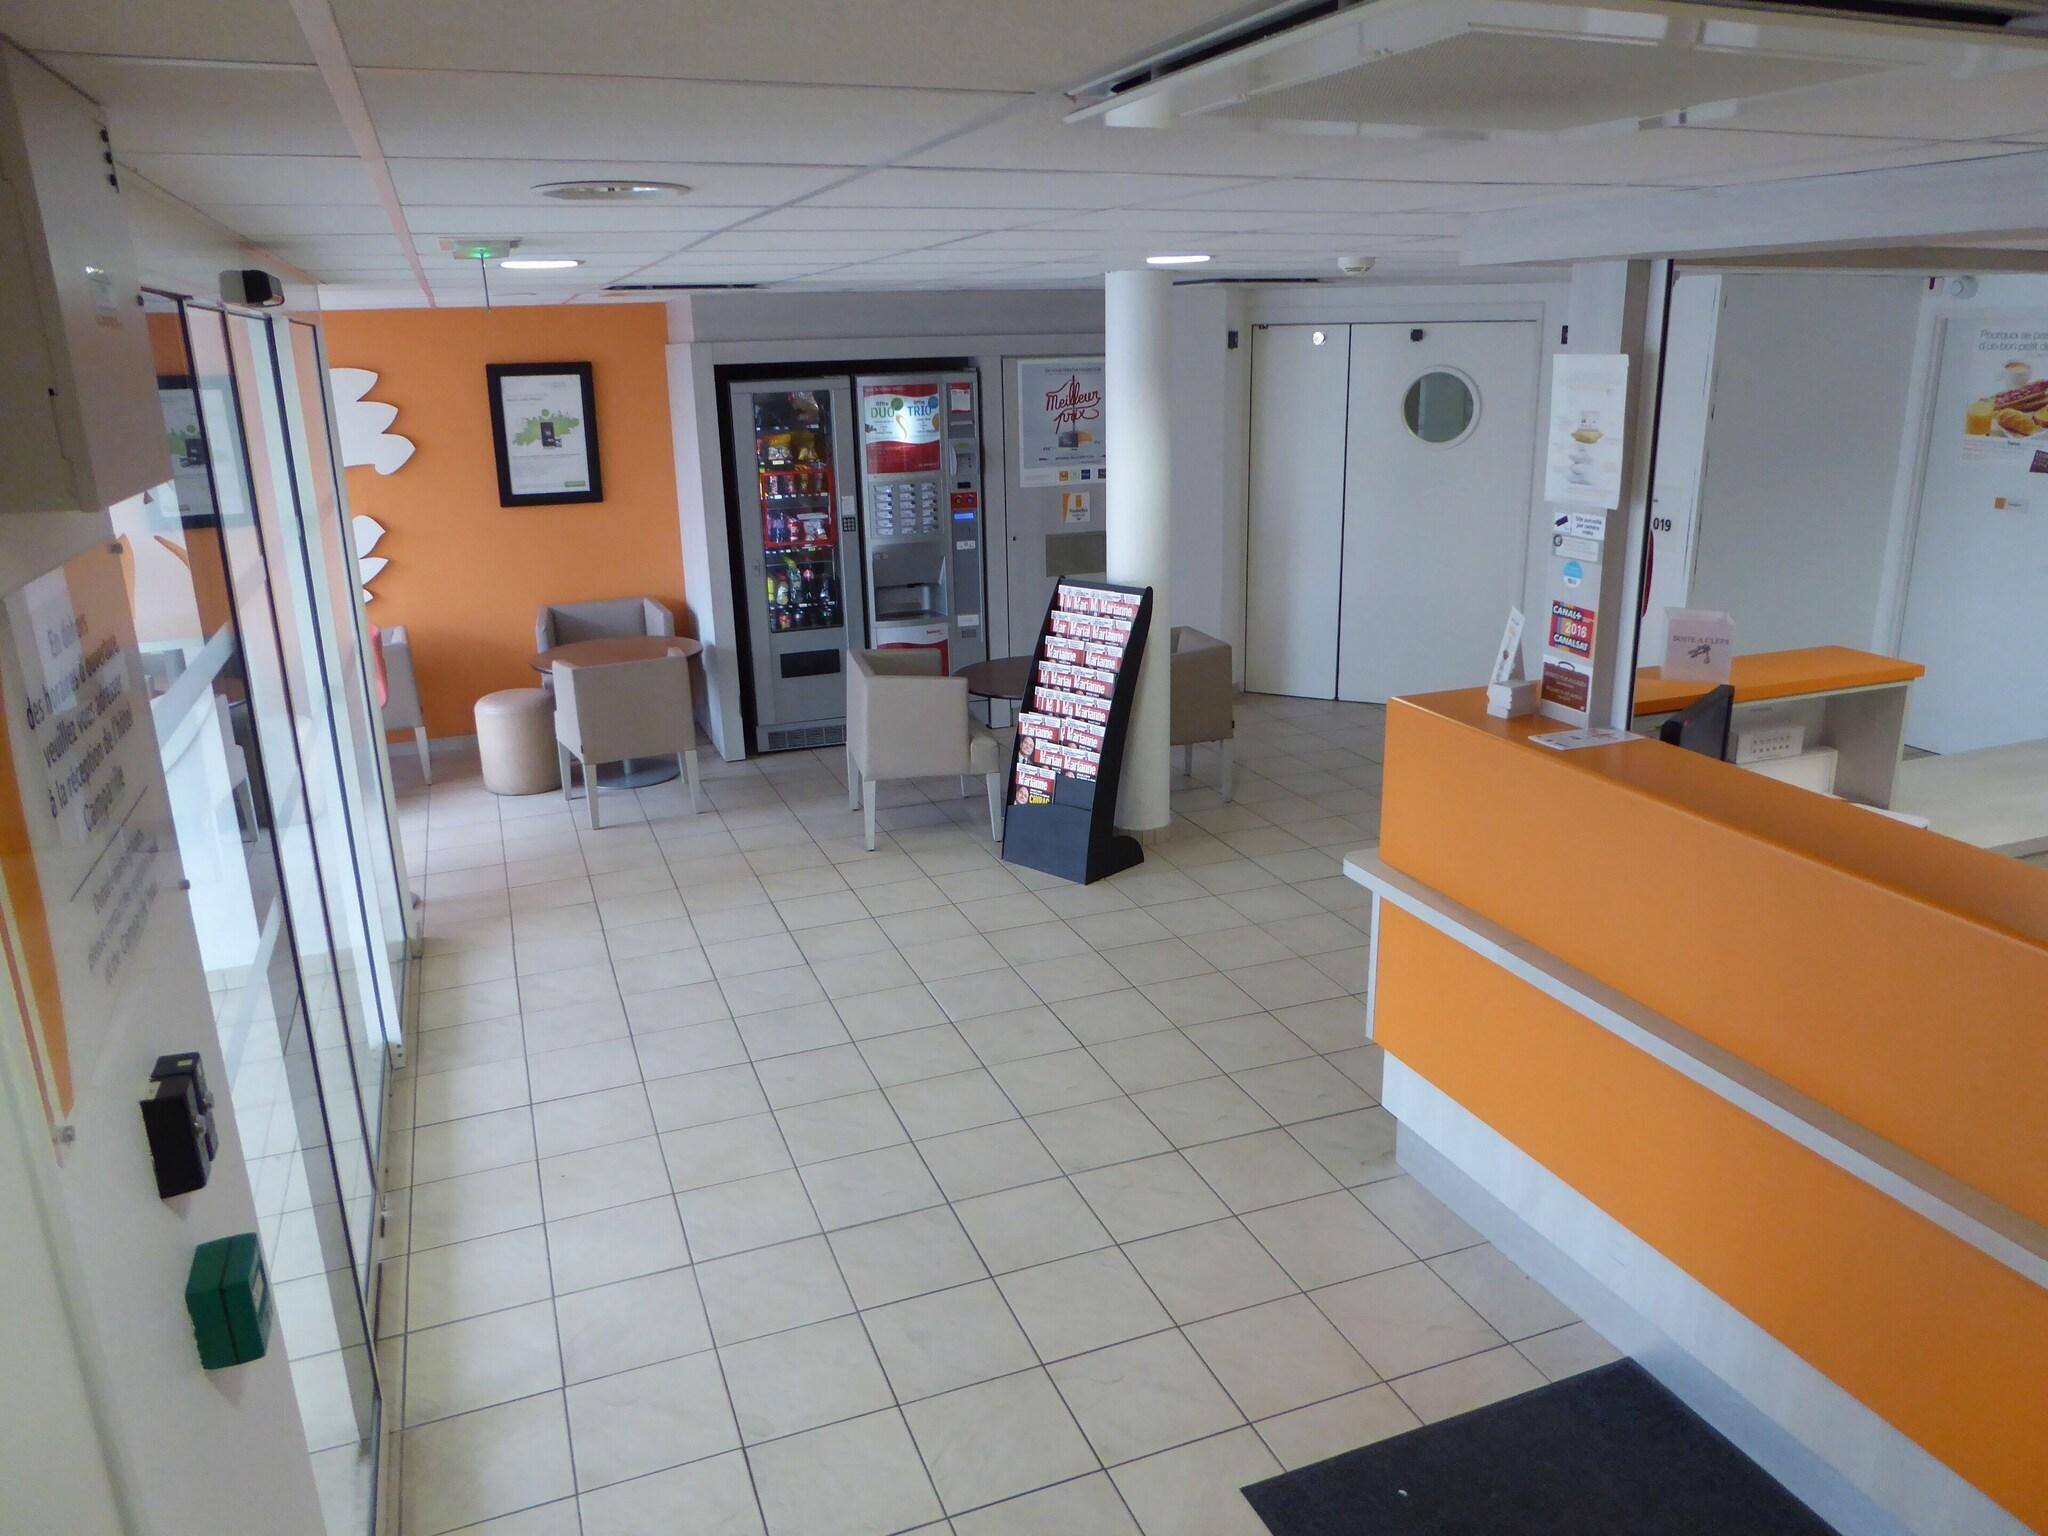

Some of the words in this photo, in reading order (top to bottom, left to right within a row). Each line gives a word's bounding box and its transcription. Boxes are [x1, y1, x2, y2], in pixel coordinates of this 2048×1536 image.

[1046, 382, 1101, 411] Meilleur
[871, 406, 895, 418] DUO
[908, 405, 932, 418] TRIO
[1054, 408, 1100, 434] prix
[1652, 517, 1672, 532] 019
[1101, 599, 1133, 618] Marianne
[1553, 605, 1582, 620] CANAL+
[1092, 625, 1124, 643] Marianne
[1553, 633, 1588, 652] CANALSAT
[1046, 643, 1077, 662] Marianne
[1085, 651, 1116, 670] Marianne
[1074, 674, 1105, 694] Marianne
[26, 696, 45, 730] des
[1075, 702, 1106, 722] Marianne
[1022, 721, 1053, 740] Marianne
[1066, 726, 1098, 748] Marianne
[43, 719, 78, 768] veuillez
[55, 780, 69, 809] la
[67, 742, 105, 797] réception
[103, 727, 114, 755] de
[1064, 755, 1097, 775] Marianne
[1019, 770, 1048, 791] Marianne
[84, 765, 125, 832] Campanile
